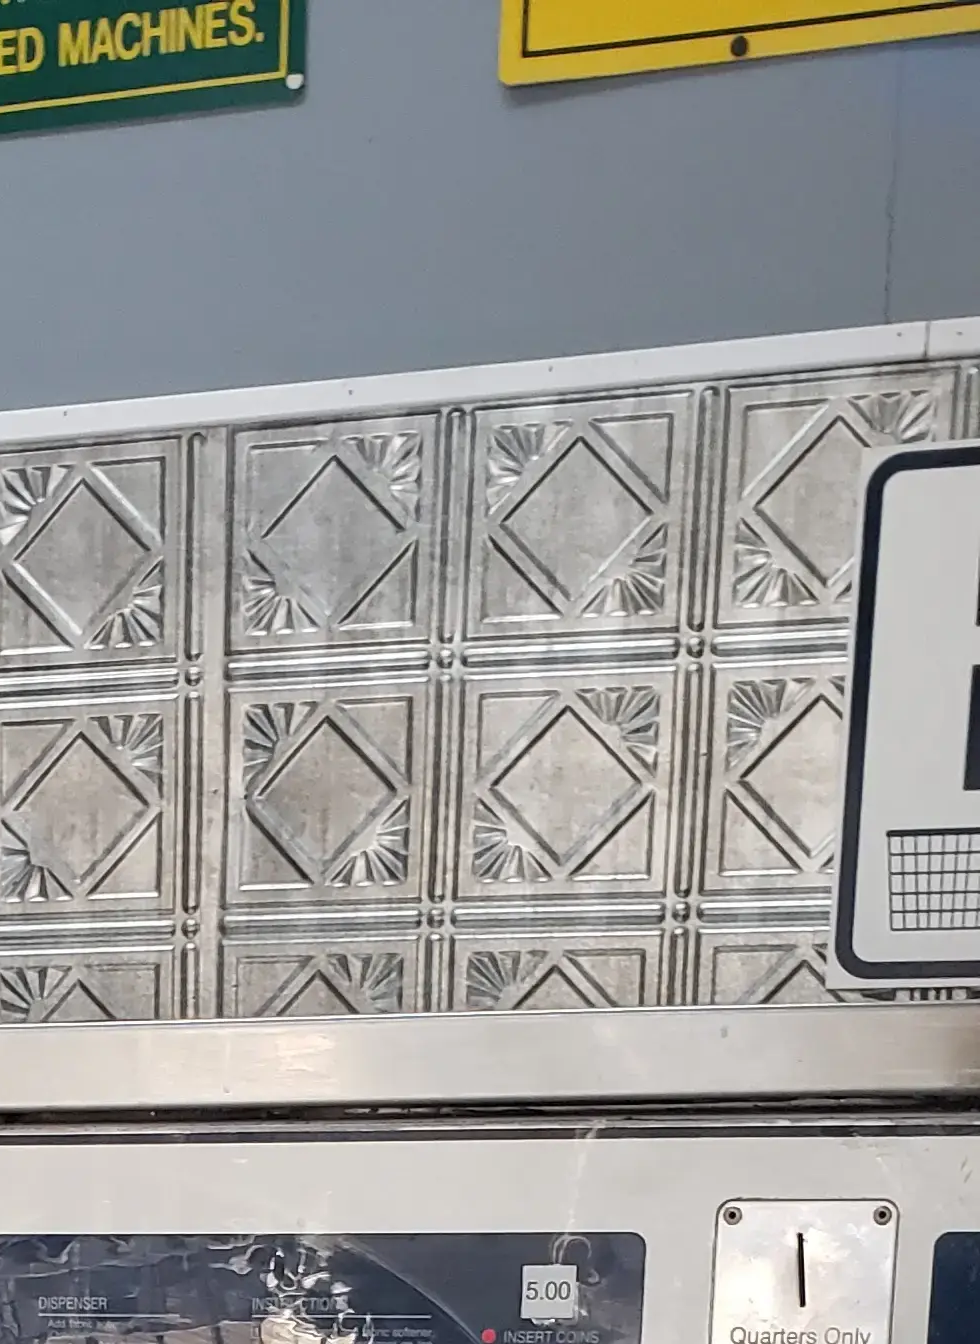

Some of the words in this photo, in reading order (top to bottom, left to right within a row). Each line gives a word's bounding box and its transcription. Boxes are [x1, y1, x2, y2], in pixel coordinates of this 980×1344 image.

[58, 1, 264, 67] MACHINES.
[526, 1281, 571, 1300] 5.00
[38, 1296, 108, 1310] DISPENSER
[503, 1331, 553, 1344] INSERT
[556, 1331, 600, 1344] COINS
